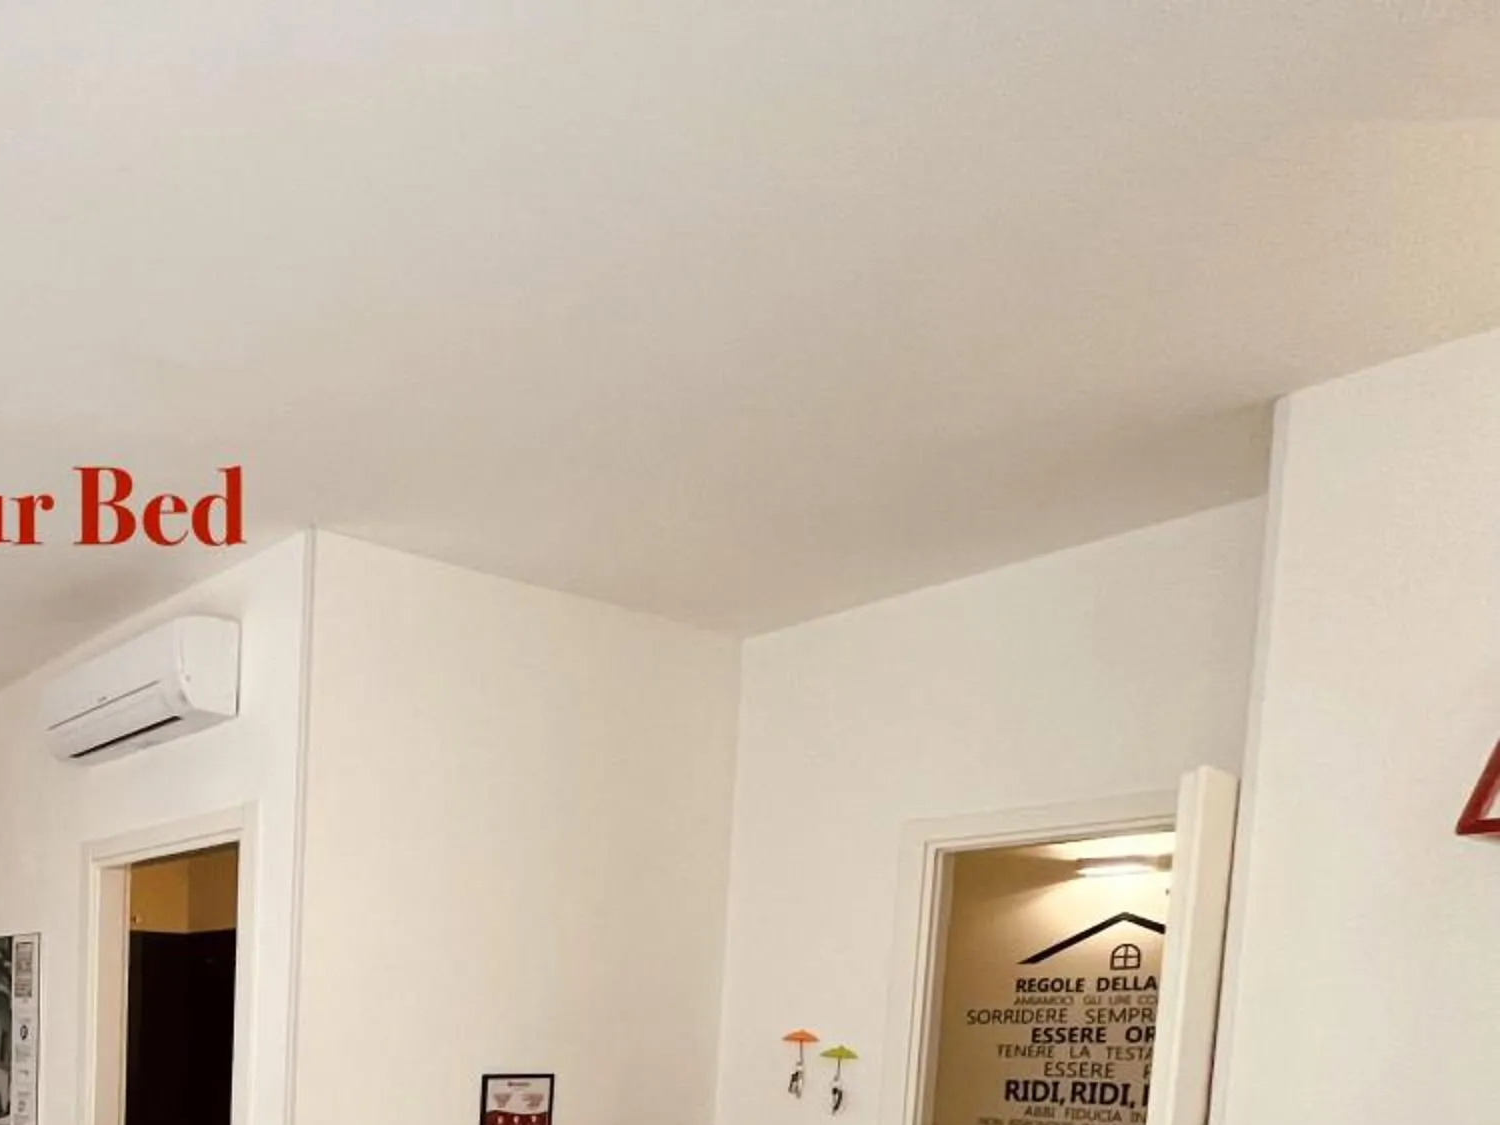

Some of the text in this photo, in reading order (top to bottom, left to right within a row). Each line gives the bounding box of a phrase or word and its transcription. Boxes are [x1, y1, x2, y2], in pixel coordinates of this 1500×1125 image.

[1015, 976, 1158, 993] REGOLE DELLA
[966, 1007, 1155, 1025] SORRIDERE SEMPR
[1031, 1026, 1156, 1044] ESSERE OR
[997, 1044, 1055, 1060] TENERE
[1069, 1045, 1091, 1060] LA
[1044, 1061, 1116, 1079] ESSERE
[1004, 1079, 1066, 1106] RIDI,
[1064, 1107, 1122, 1122] FIDUCIA
